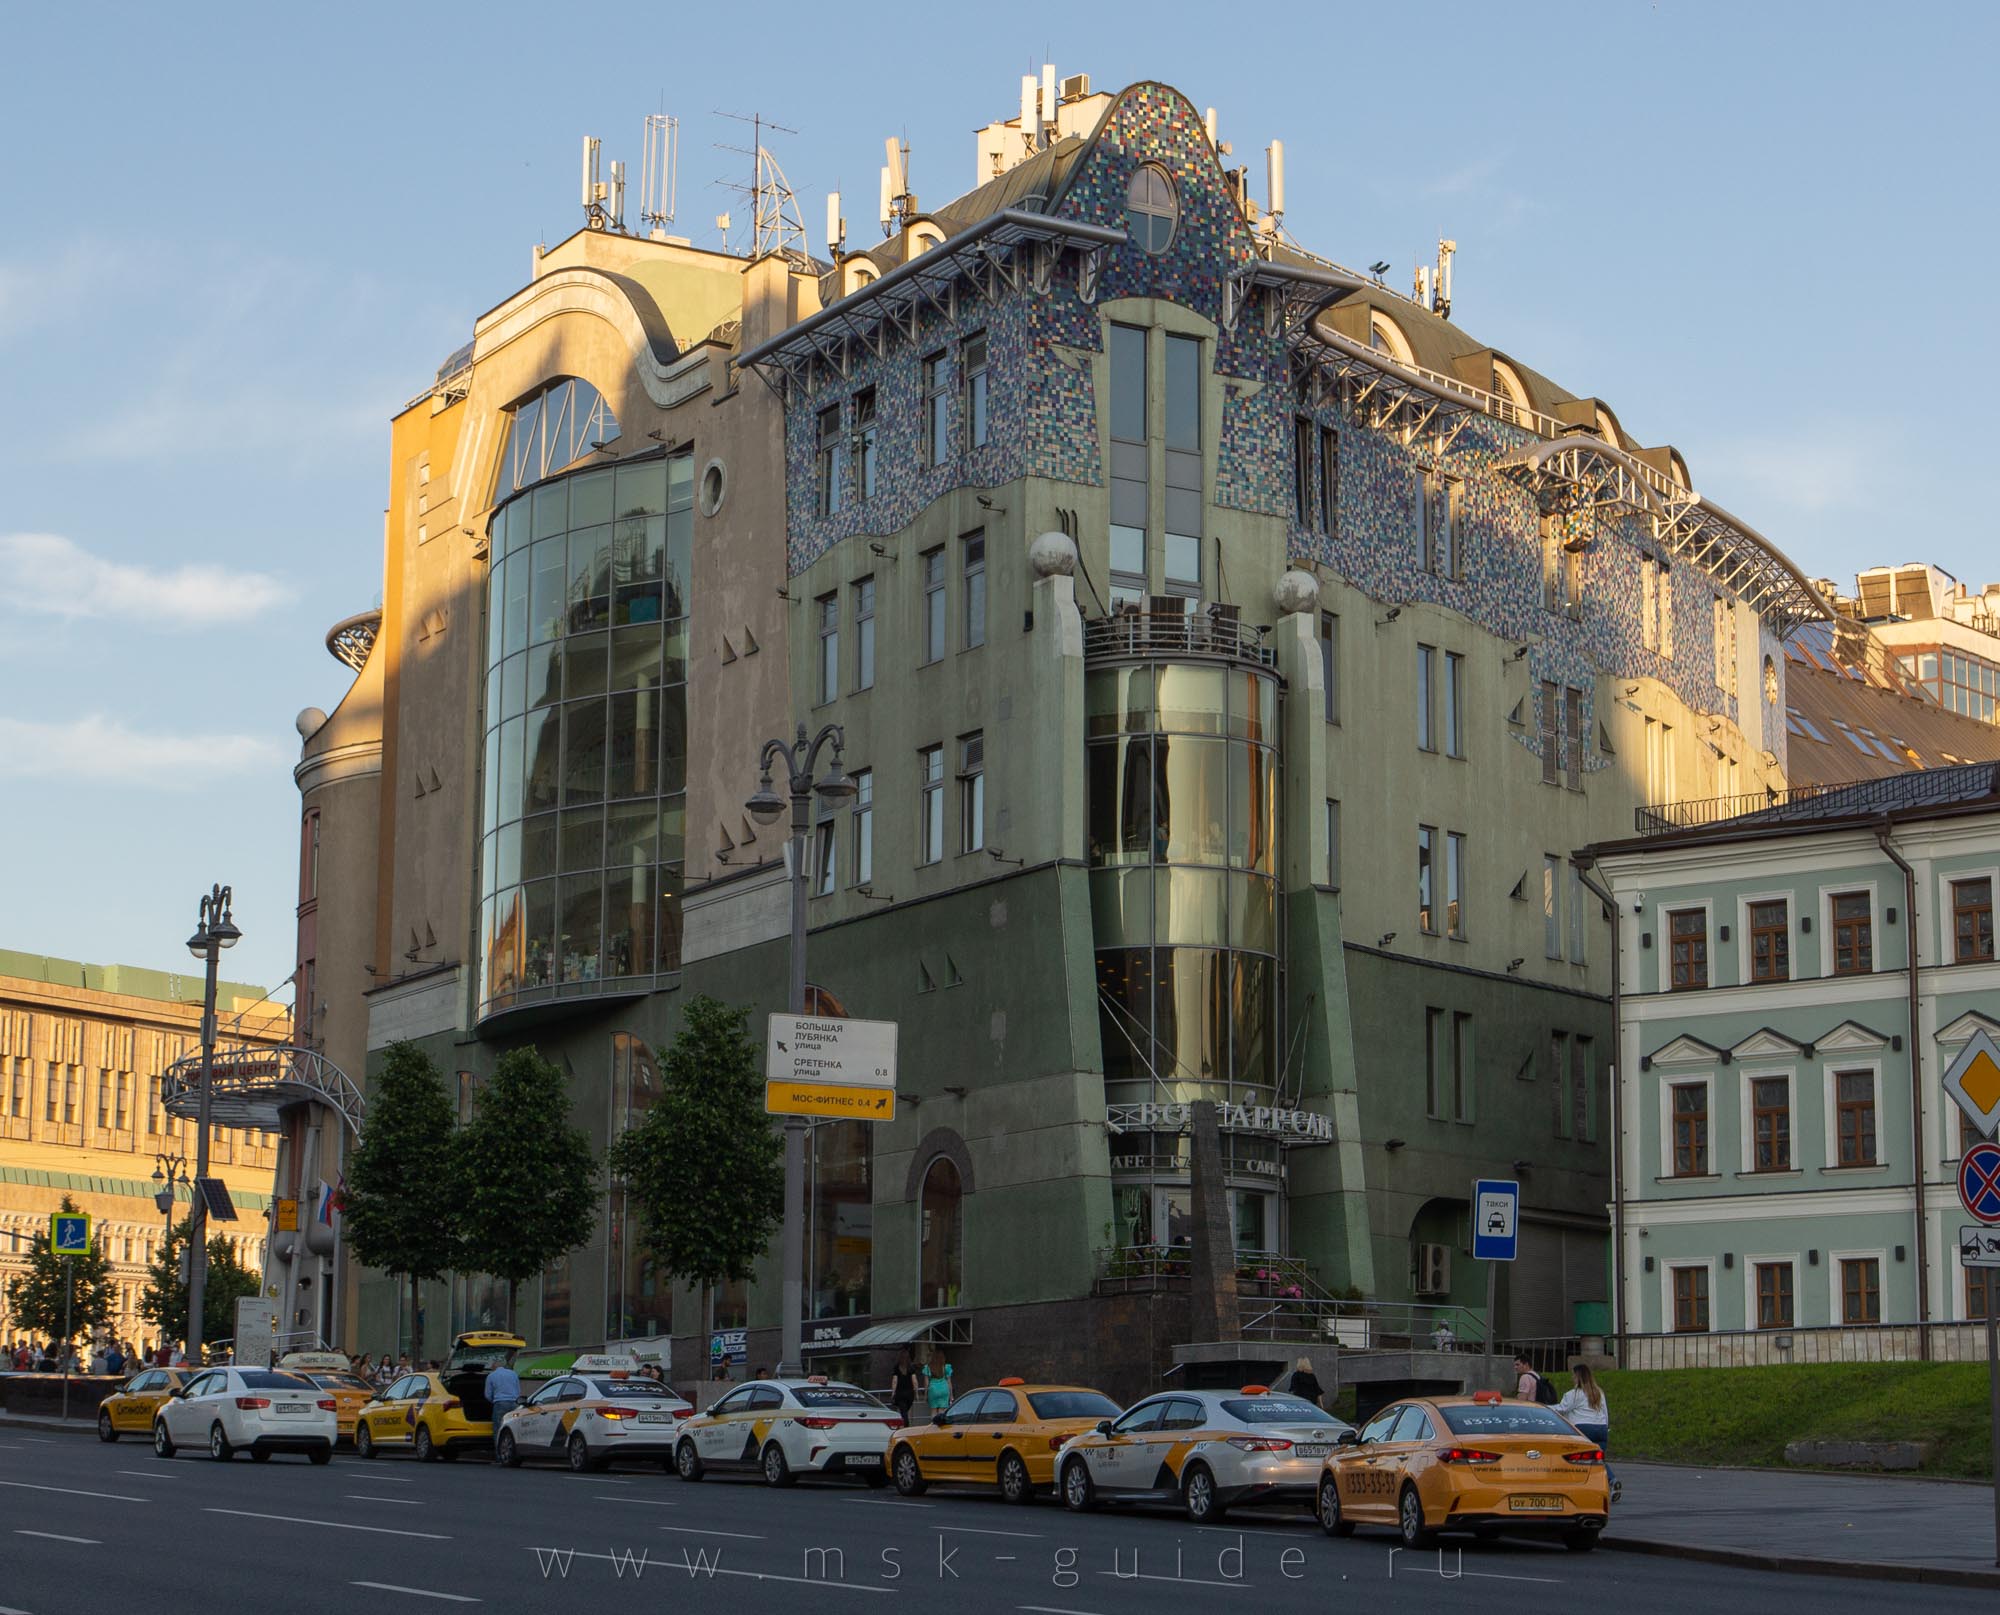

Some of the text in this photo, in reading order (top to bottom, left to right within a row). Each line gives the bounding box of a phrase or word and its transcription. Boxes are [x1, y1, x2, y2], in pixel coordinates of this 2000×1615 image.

[796, 1021, 843, 1032] БОЛЬШАЯ
[795, 1032, 838, 1042] ЛУБЯНКА
[795, 1042, 821, 1050] улица
[794, 1058, 842, 1069] СРЕТЕНКА
[186, 1063, 277, 1082] ТОРВЫЙ ЦЕНТР
[794, 1068, 888, 1076] улица 0.8
[792, 1094, 854, 1106] МОС-ФИТНЕС
[1111, 1155, 1145, 1168] AFE
[723, 1332, 747, 1345] TEZ
[1529, 1498, 1546, 1507] 700
